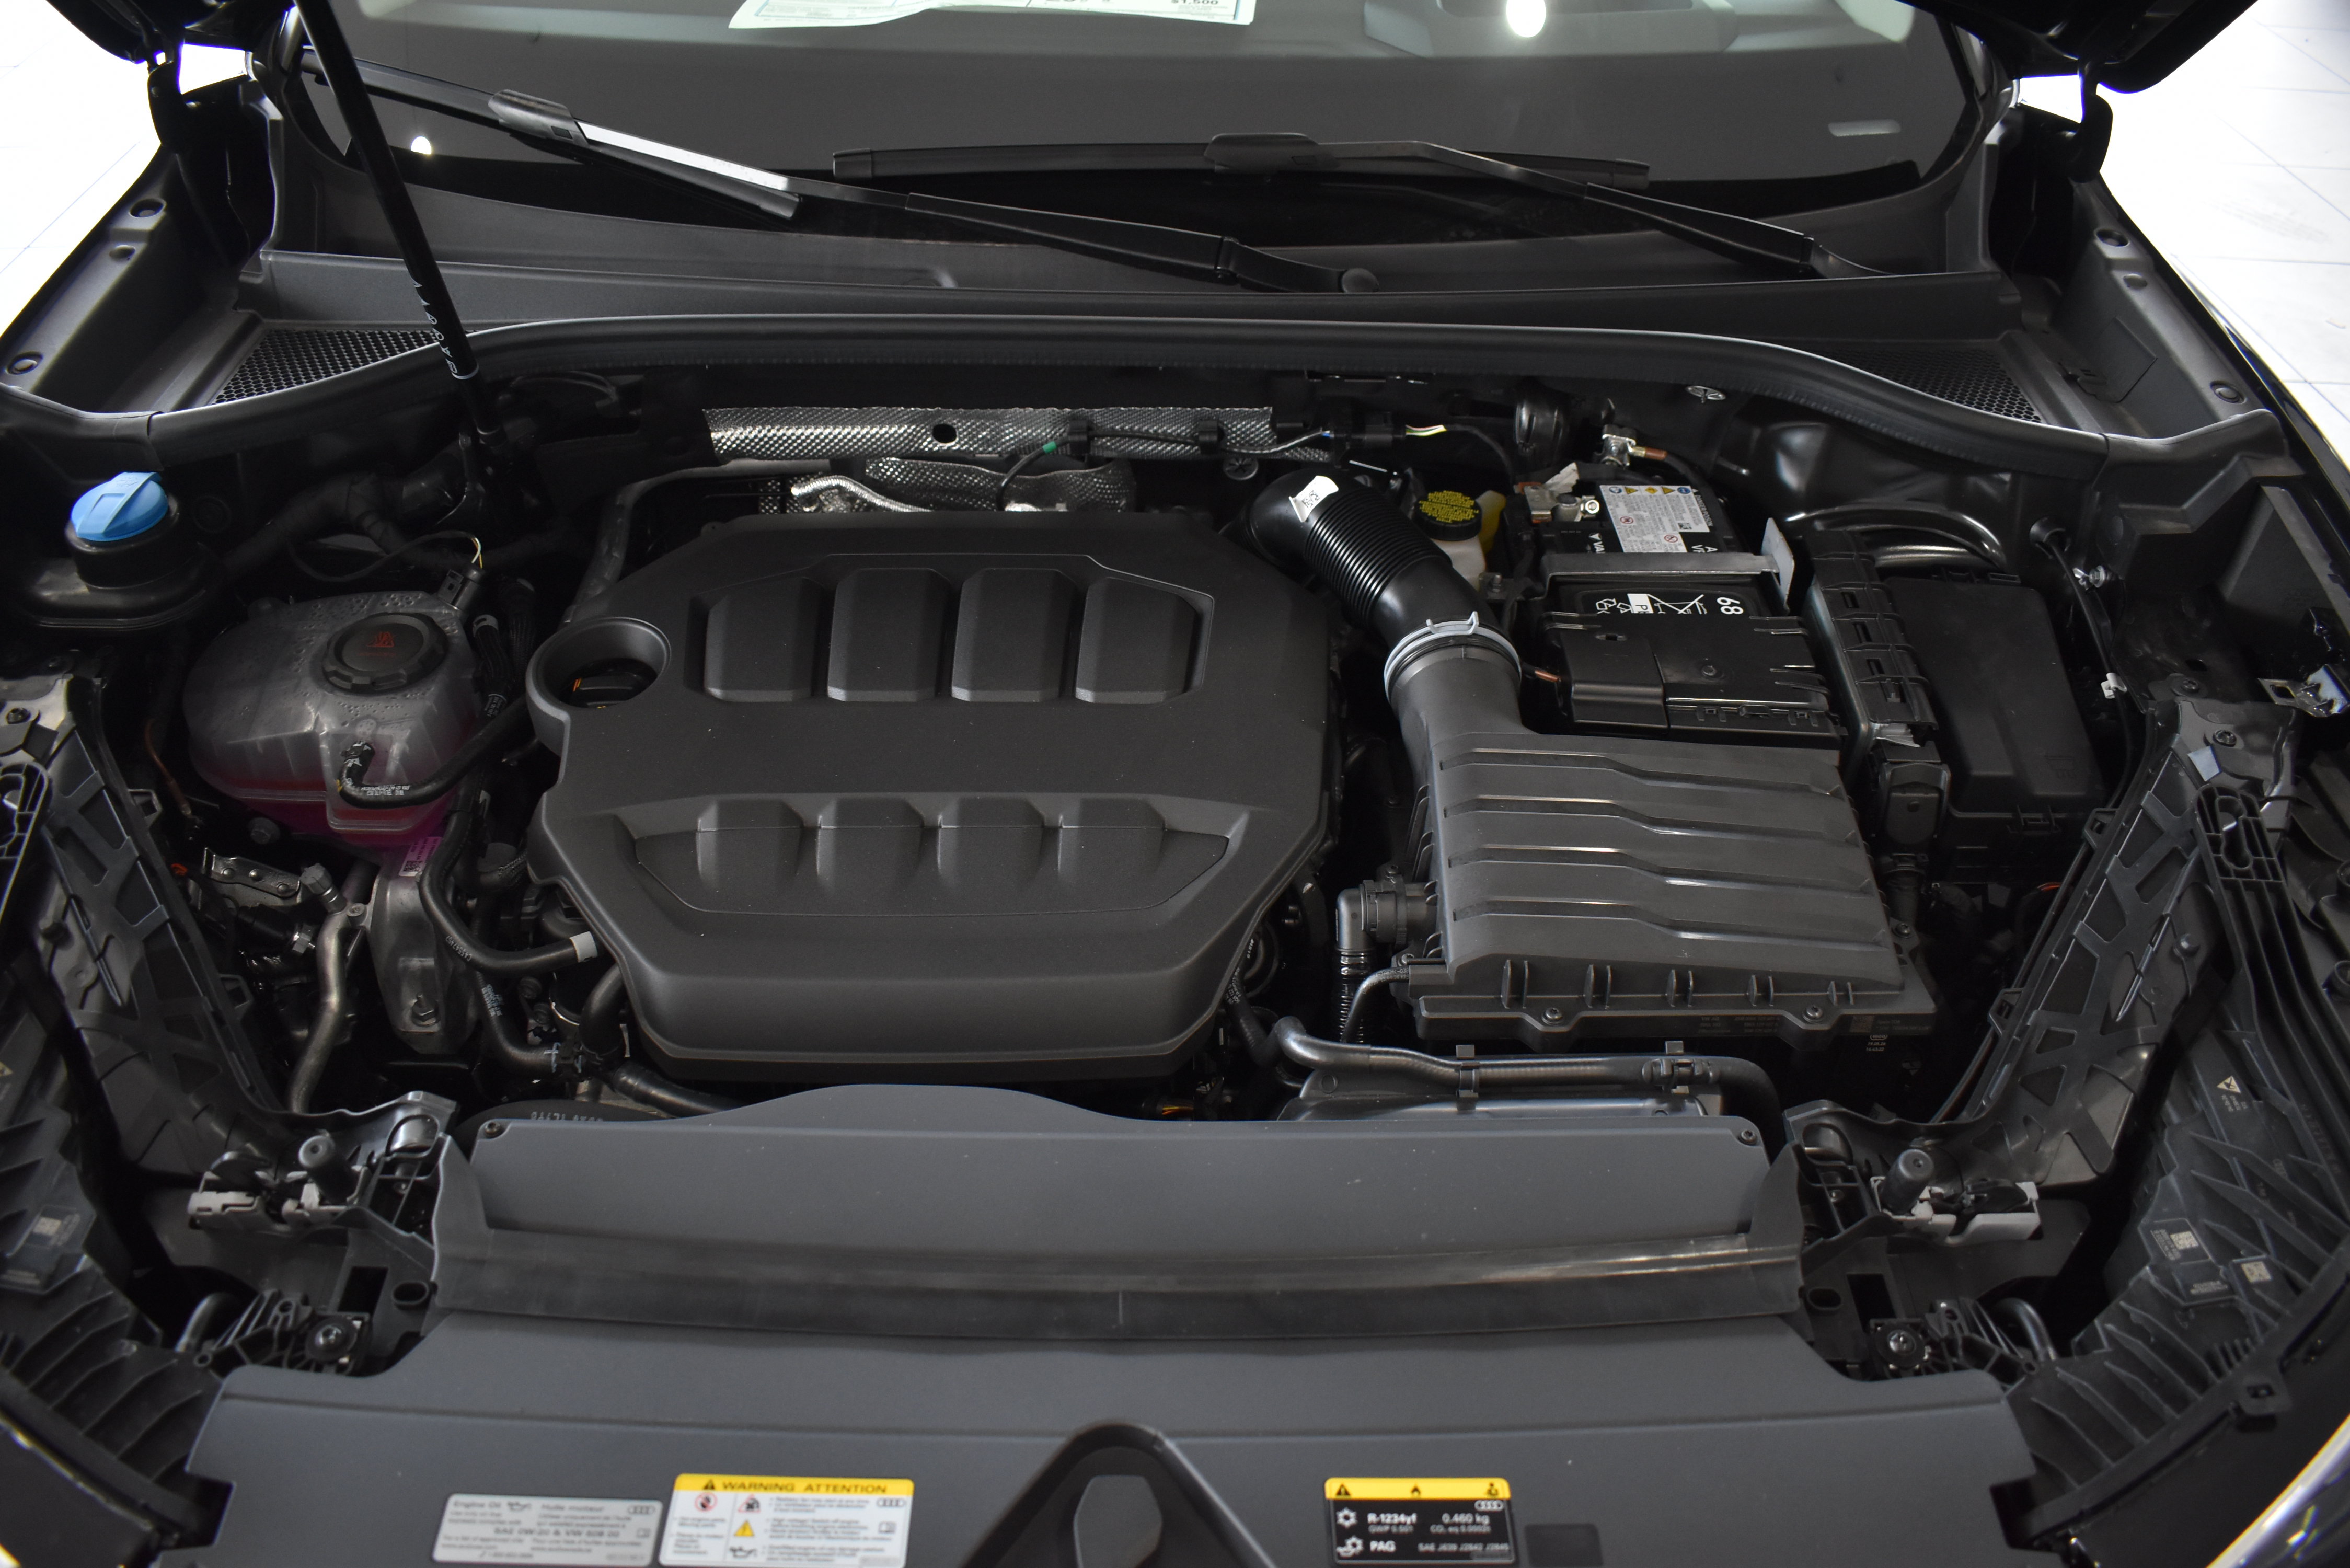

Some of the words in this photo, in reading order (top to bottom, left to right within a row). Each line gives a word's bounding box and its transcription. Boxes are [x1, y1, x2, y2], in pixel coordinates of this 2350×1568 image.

[722, 1481, 795, 1492] WARNING
[804, 1483, 888, 1493] ATTENTION
[453, 1500, 486, 1509] Engine
[1367, 1513, 1418, 1525] R-1234yf
[1474, 1513, 1490, 1526] kg
[1369, 1540, 1397, 1552] PAG
